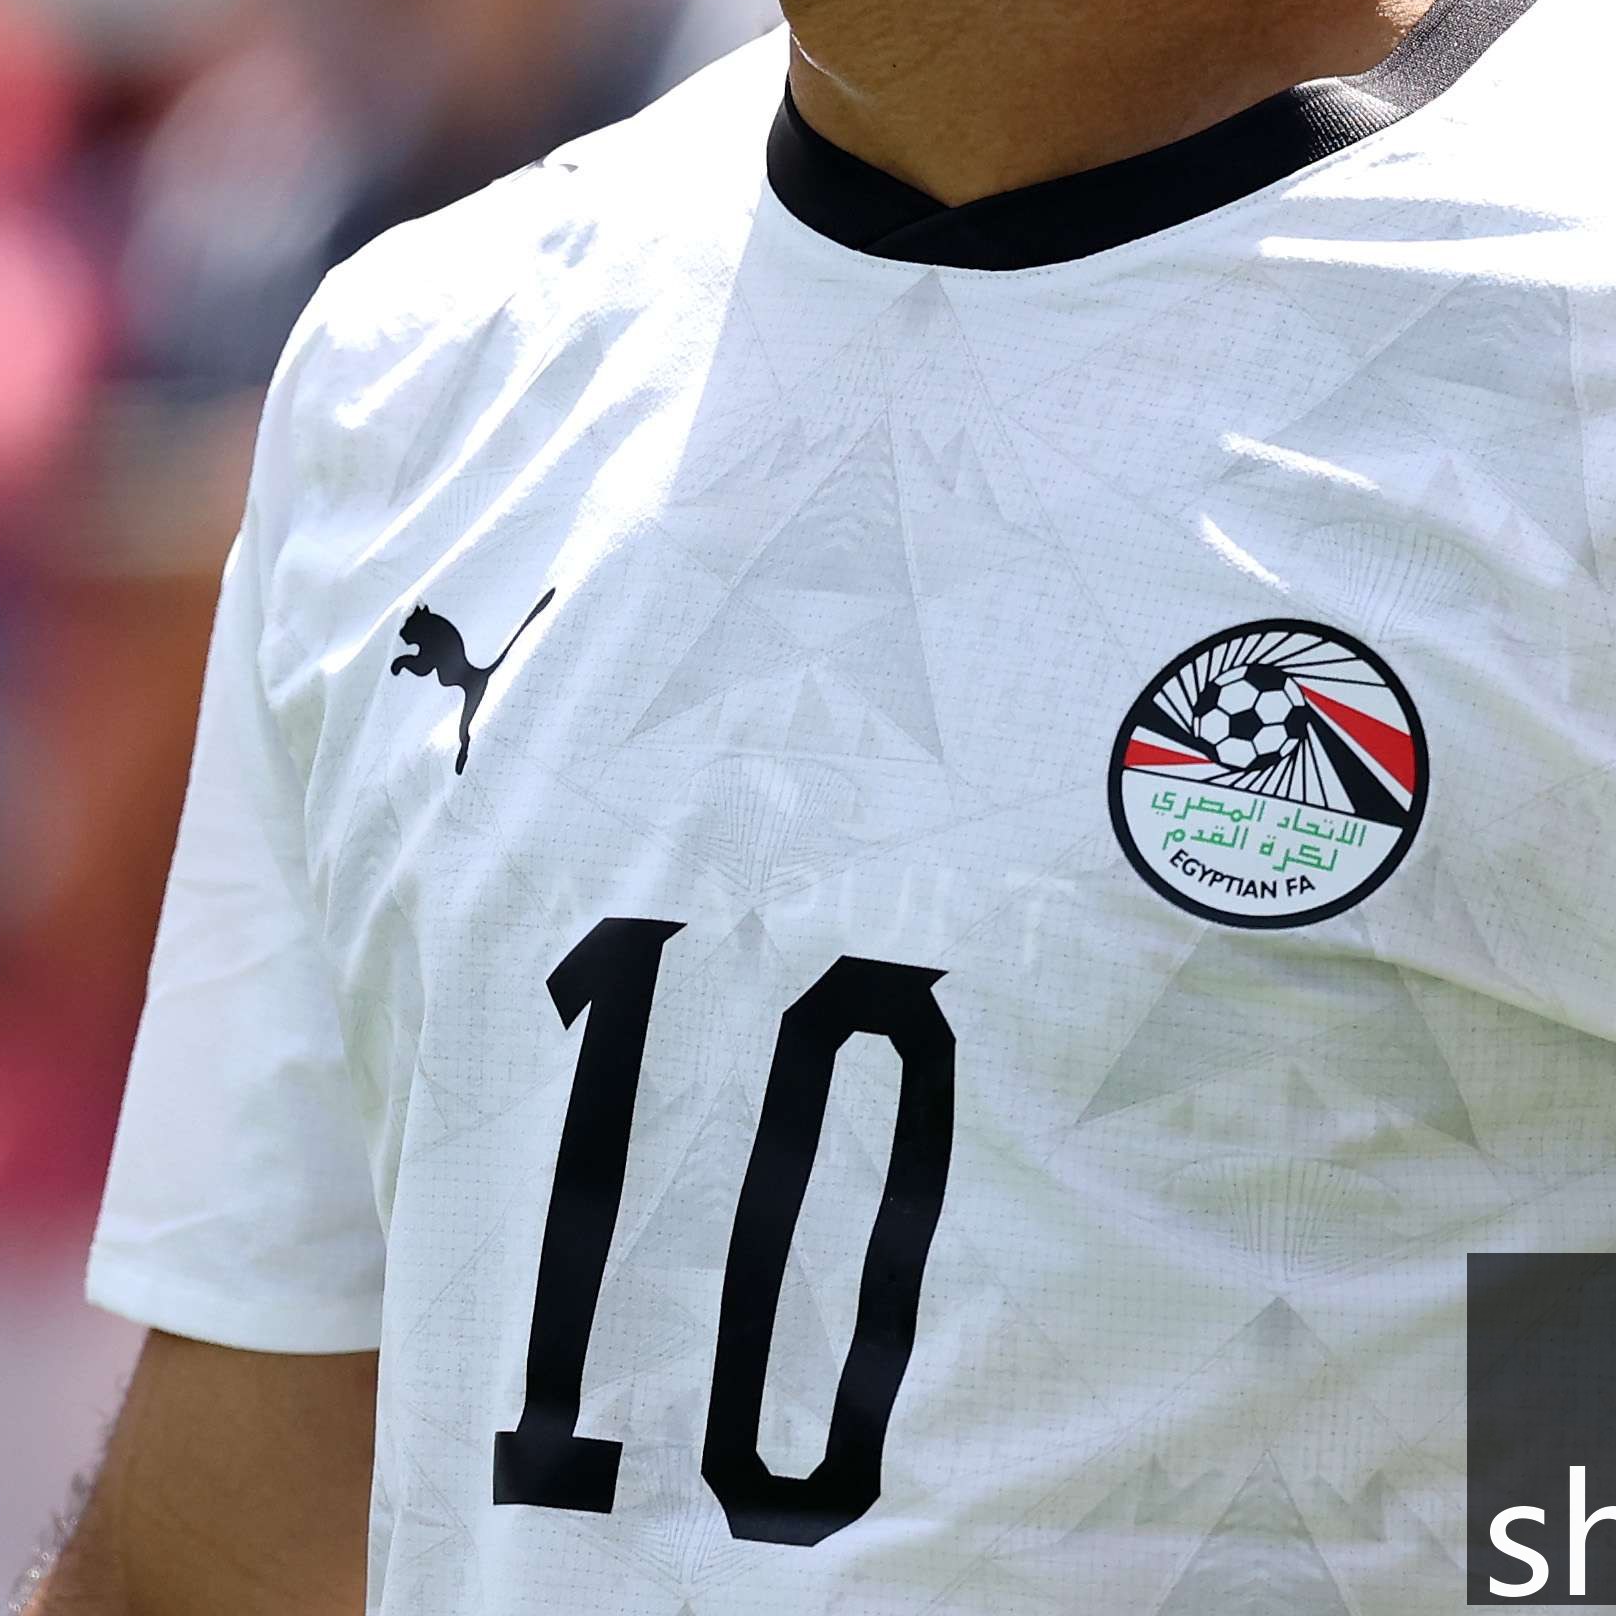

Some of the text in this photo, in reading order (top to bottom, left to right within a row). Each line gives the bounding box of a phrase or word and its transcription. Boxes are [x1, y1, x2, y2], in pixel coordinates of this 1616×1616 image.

[1151, 791, 1367, 847] الاتحاد المصري
[1162, 825, 1339, 872] لكرة القدم
[1168, 848, 1316, 899] EGYPTIAN FA
[492, 916, 957, 1548] 10
